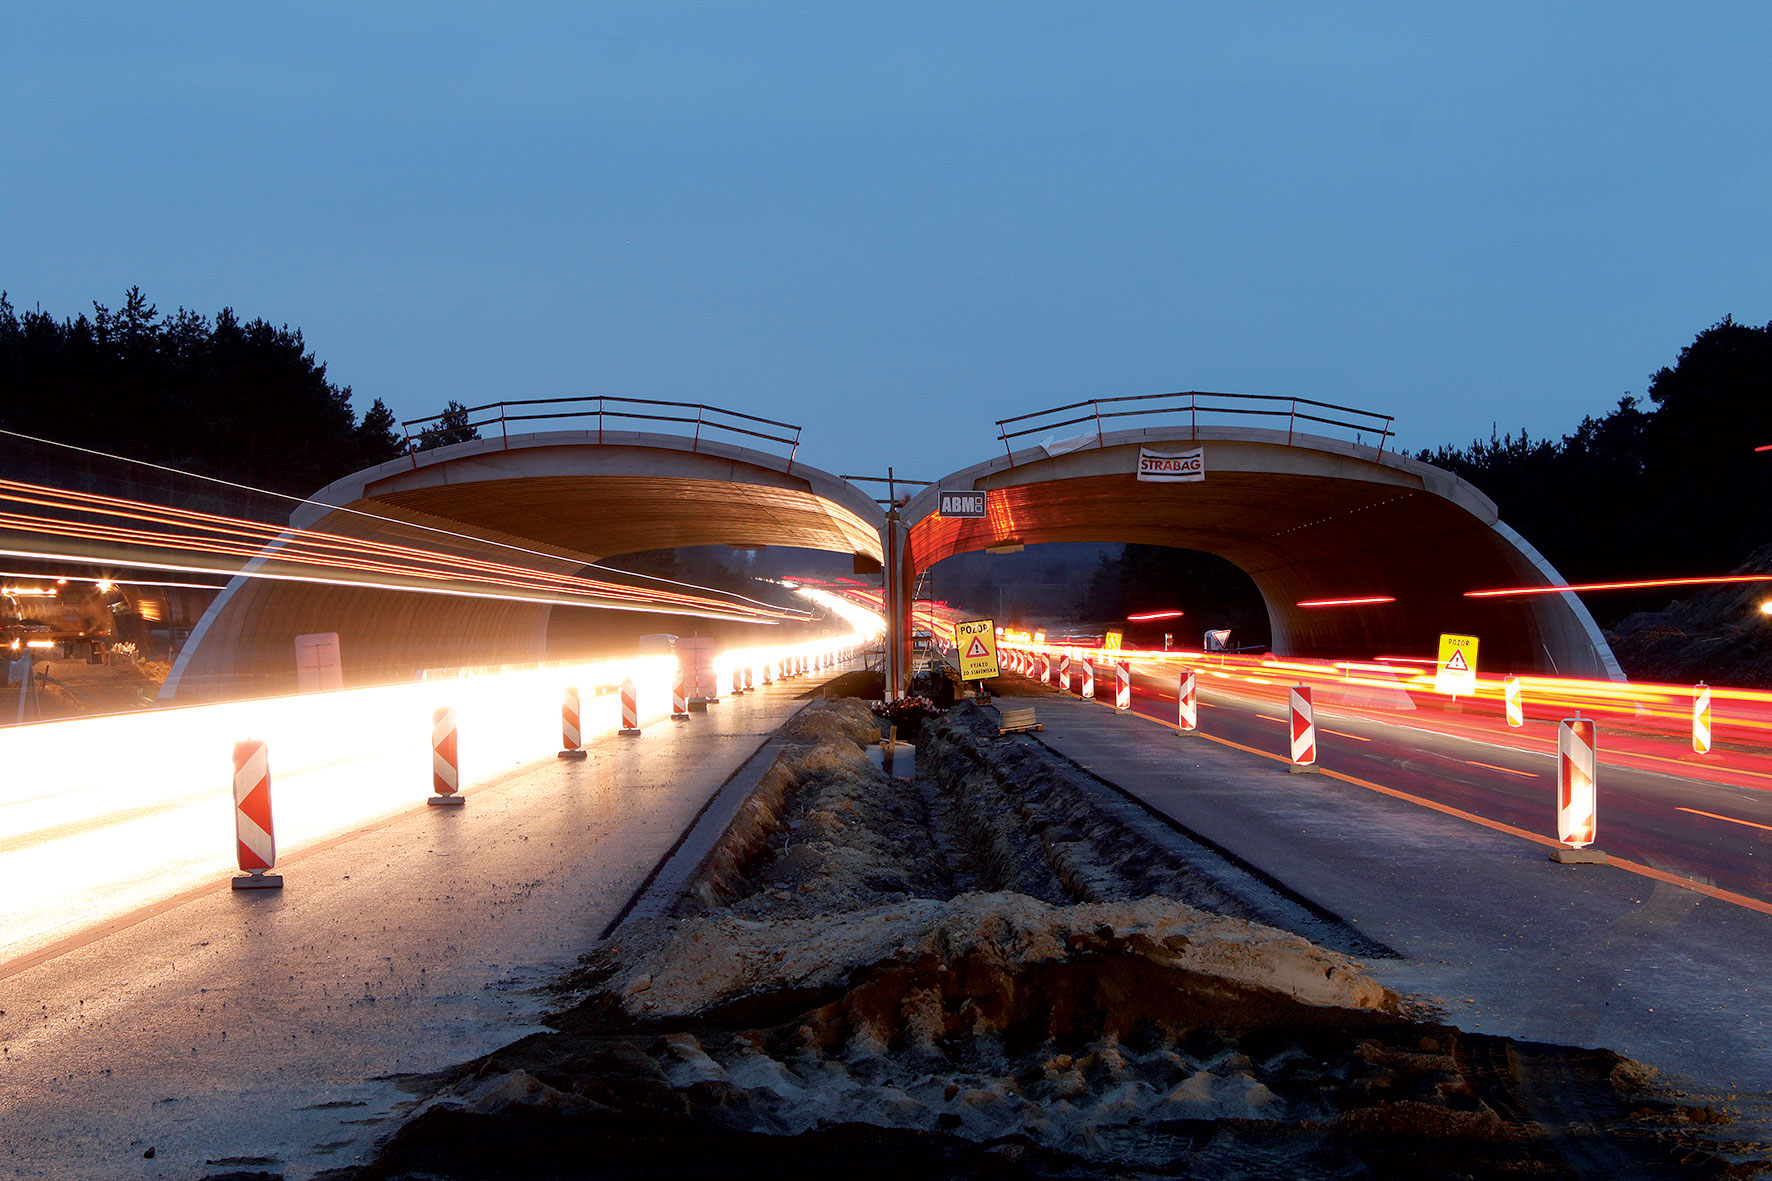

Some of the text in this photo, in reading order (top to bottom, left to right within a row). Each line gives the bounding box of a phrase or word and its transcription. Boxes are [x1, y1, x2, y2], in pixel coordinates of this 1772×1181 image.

[1141, 459, 1201, 471] STRABAG
[941, 496, 975, 513] ABM
[1448, 638, 1470, 647] POZOR
